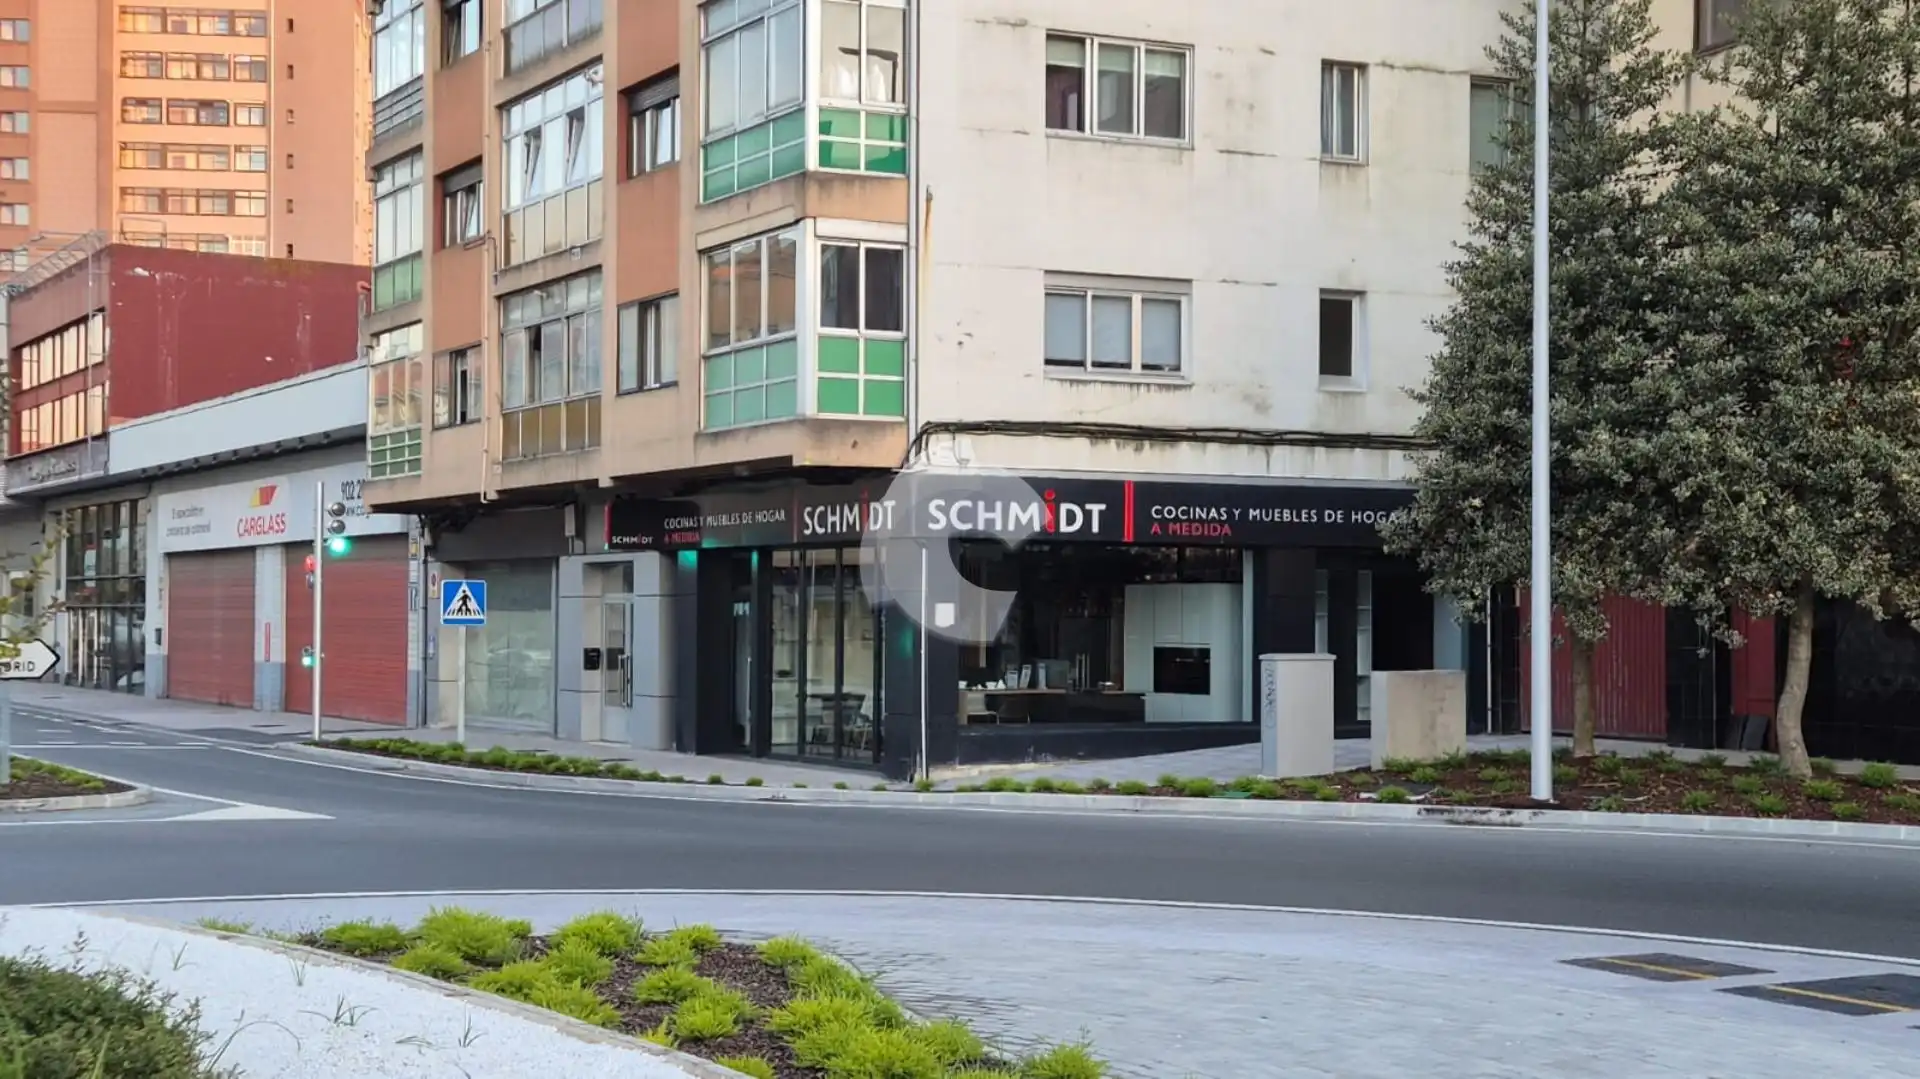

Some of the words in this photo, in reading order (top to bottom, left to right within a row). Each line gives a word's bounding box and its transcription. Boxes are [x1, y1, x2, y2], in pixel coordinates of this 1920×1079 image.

[664, 515, 698, 529] COCINAS
[706, 511, 740, 528] MUEBLES
[742, 511, 753, 525] DE
[755, 508, 786, 523] HOGAR
[1151, 505, 1227, 521] COCINAS
[1232, 508, 1241, 521] Y
[1249, 508, 1317, 523] MUEBLES
[1324, 509, 1344, 524] DE
[1351, 509, 1399, 524] HOGA
[237, 512, 286, 538] CARGLASS
[1151, 522, 1162, 535] A
[1168, 523, 1232, 537] MEDIDA
